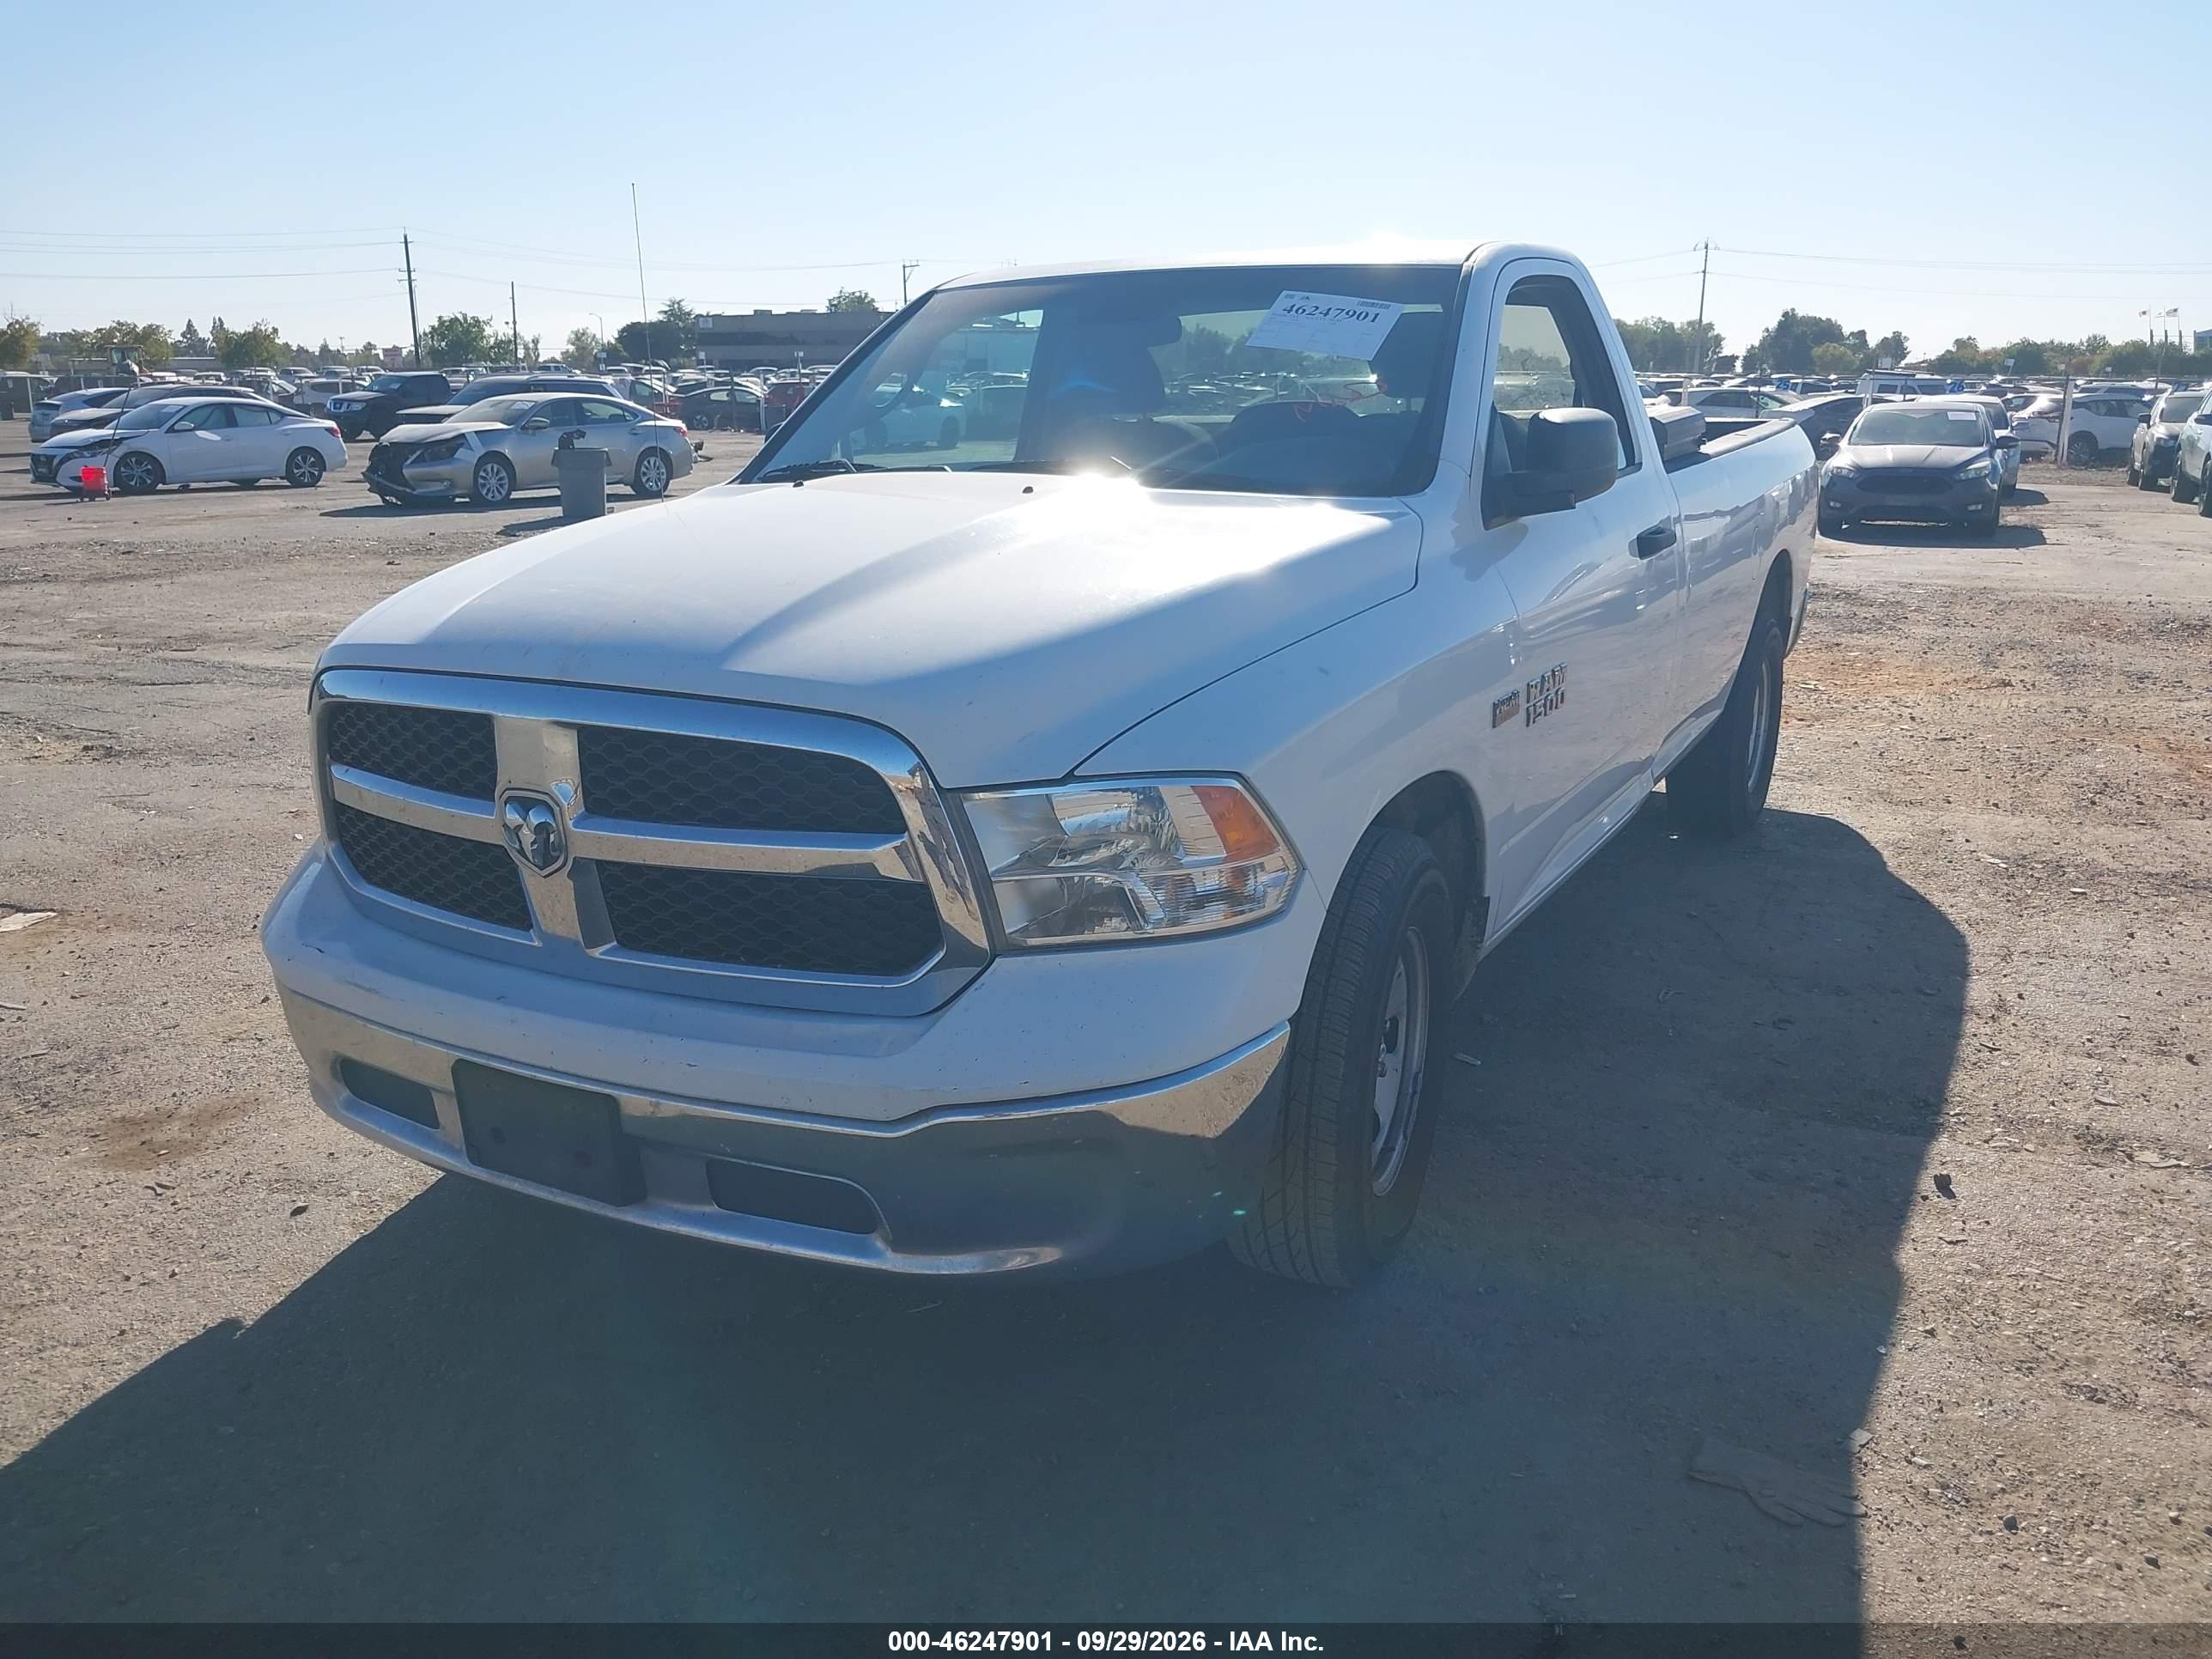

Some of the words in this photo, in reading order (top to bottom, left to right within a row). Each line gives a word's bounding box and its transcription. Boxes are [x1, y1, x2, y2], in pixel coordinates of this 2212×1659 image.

[1283, 303, 1380, 323] 46247901
[1526, 661, 1567, 703] RAM
[1525, 687, 1565, 727] 1500
